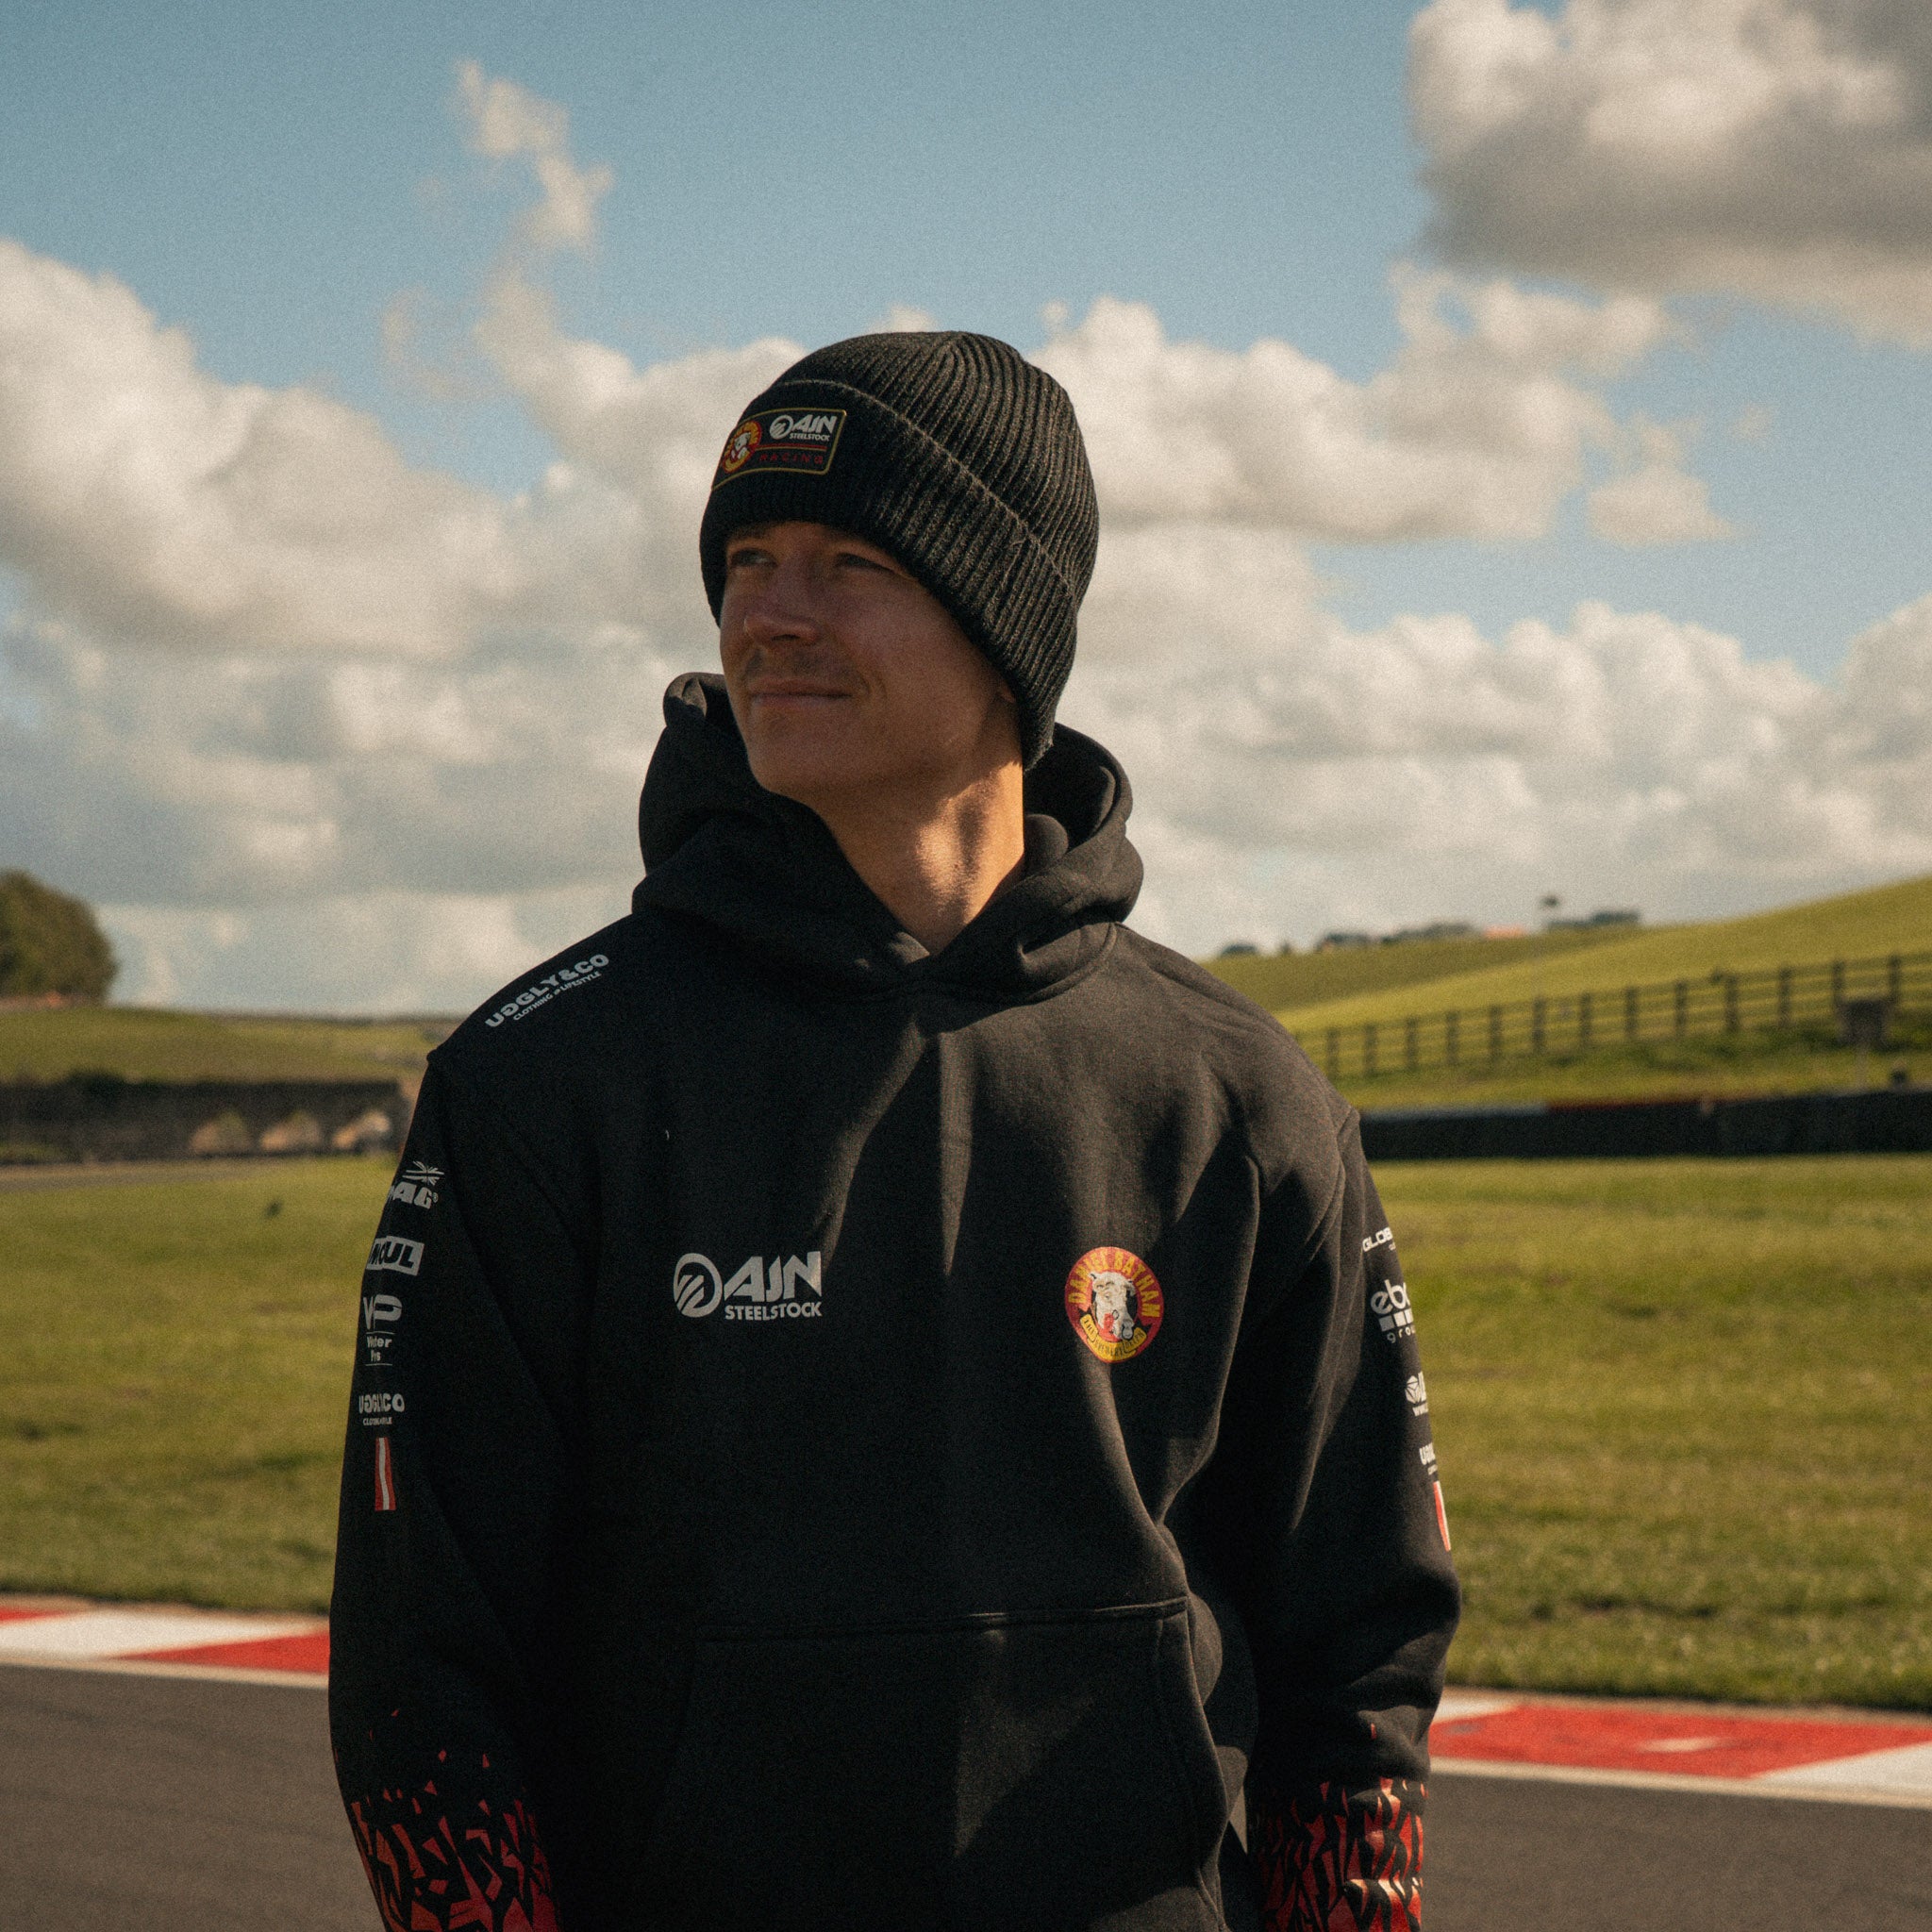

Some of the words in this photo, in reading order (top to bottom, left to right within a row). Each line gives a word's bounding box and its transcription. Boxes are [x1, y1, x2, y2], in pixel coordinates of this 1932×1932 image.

[790, 432, 831, 441] STEELSTOCK
[791, 413, 839, 434] AJN
[513, 993, 554, 1020] CLOTHING
[559, 971, 602, 991] LIFESTYLE
[724, 1251, 823, 1302] AJN
[1114, 1250, 1161, 1318] BATHAM
[362, 1294, 403, 1330] VP
[724, 1301, 823, 1321] STEELSTOCK
